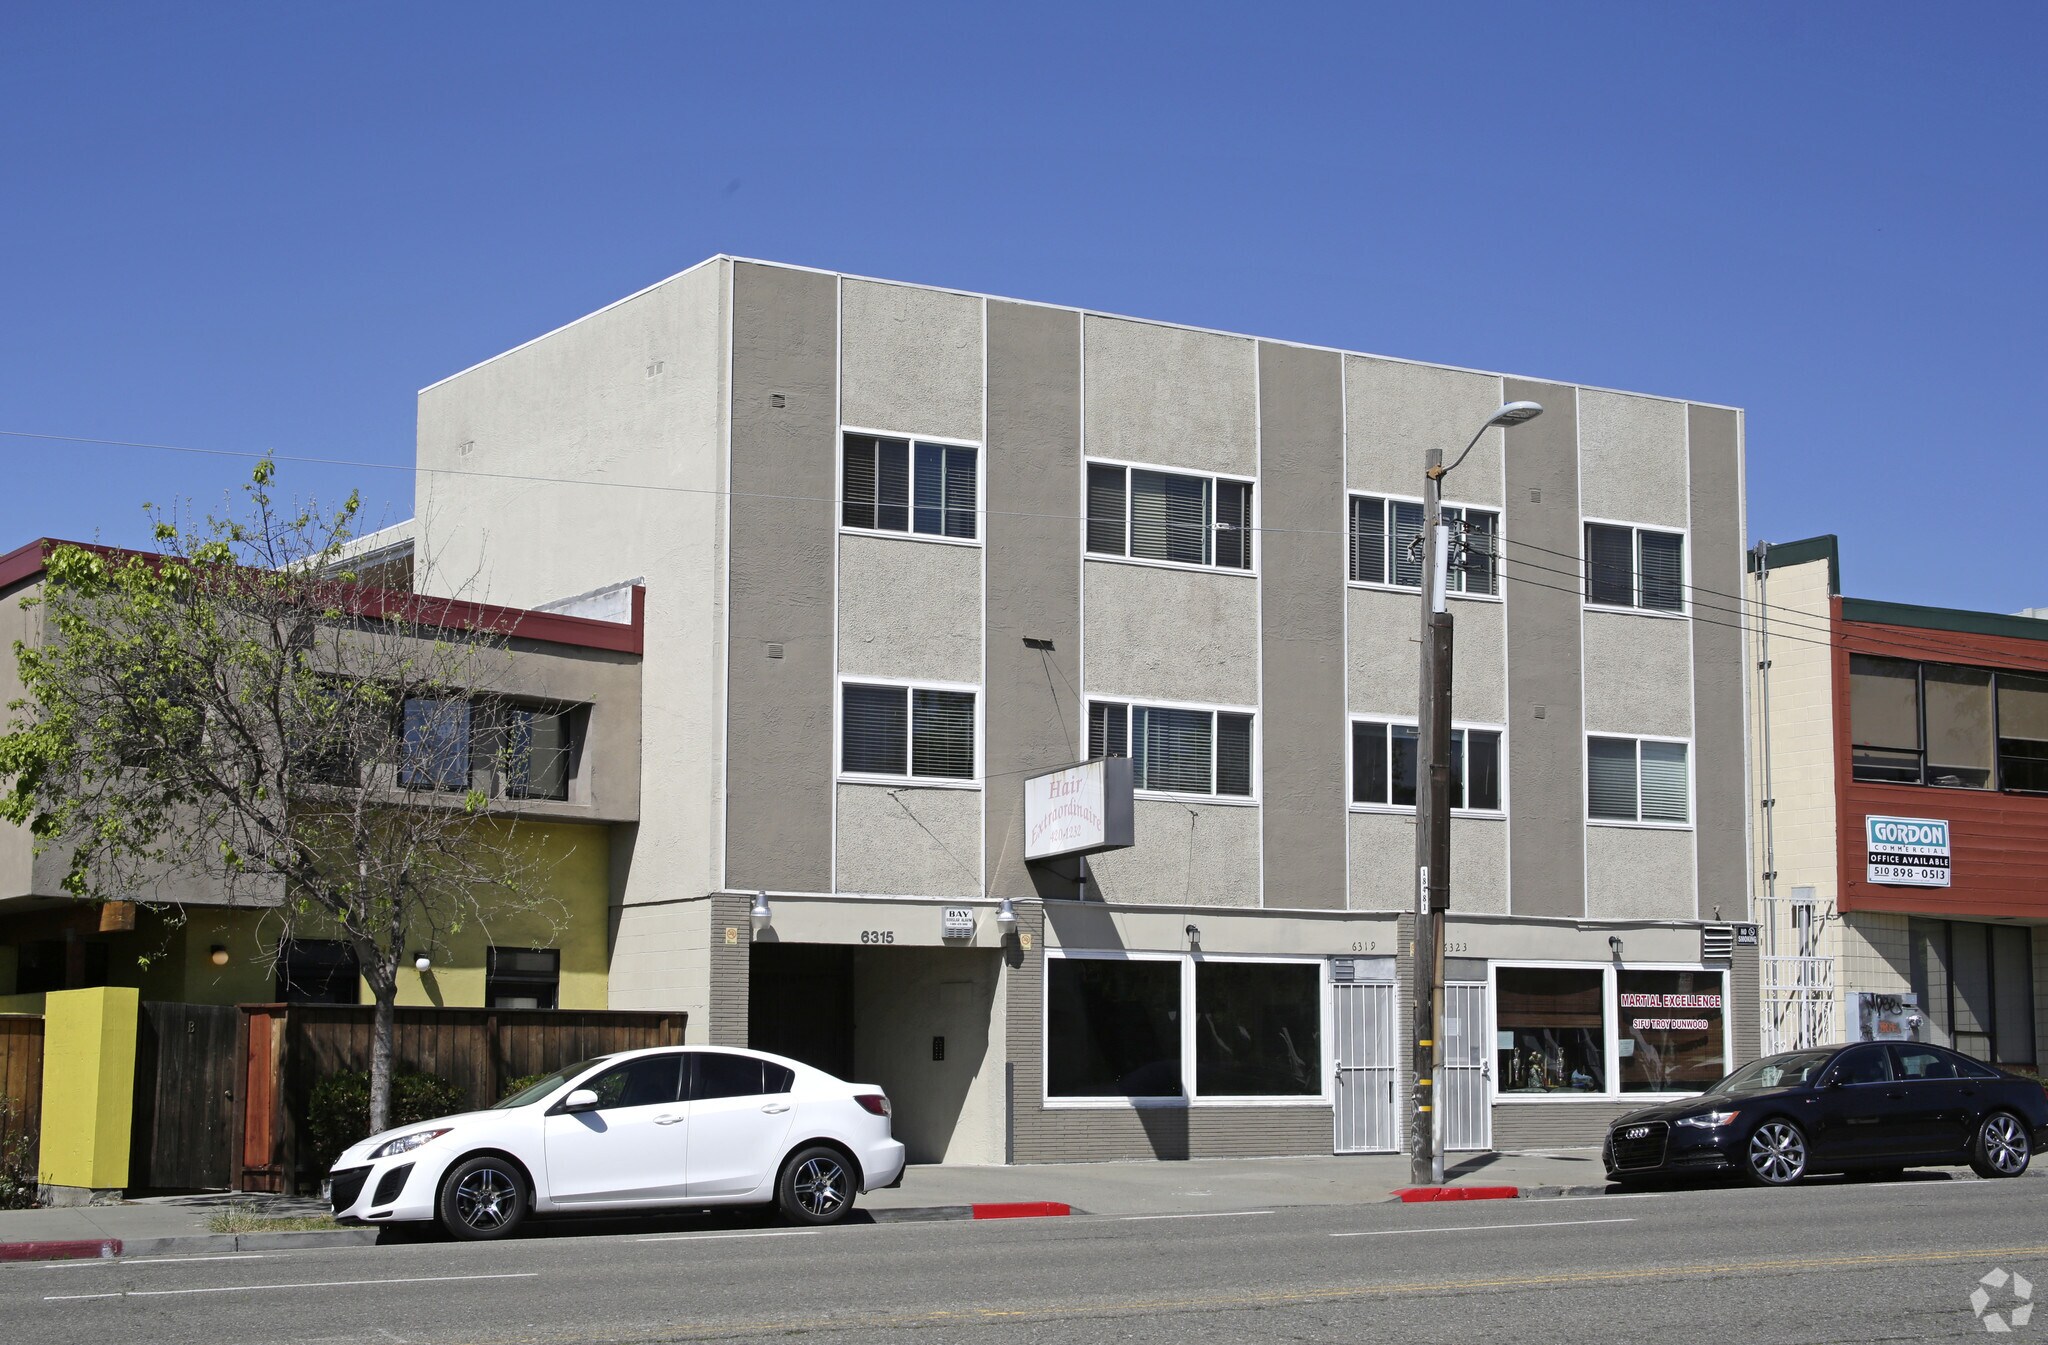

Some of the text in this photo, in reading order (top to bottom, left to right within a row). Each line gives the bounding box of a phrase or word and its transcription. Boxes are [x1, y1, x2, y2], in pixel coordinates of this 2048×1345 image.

[1048, 775, 1083, 800] Hair
[1031, 797, 1102, 848] Extraordinaire
[1874, 822, 1943, 845] GORDON
[1874, 844, 1945, 855] COMMERCIAL
[1870, 854, 1949, 866] OFFICE AVAILABLE
[1874, 866, 1890, 876] 510
[1893, 869, 1945, 880] 898-0513
[949, 910, 970, 918] BAY
[861, 930, 894, 944] 6315
[1740, 928, 1747, 936] NO
[1738, 935, 1757, 943] SMOKING
[1351, 941, 1376, 952] 6319
[1620, 993, 1721, 1008] MARTIAL EXCELLENCE
[1632, 1018, 1708, 1030] SIFU TROY DUNWOOD
